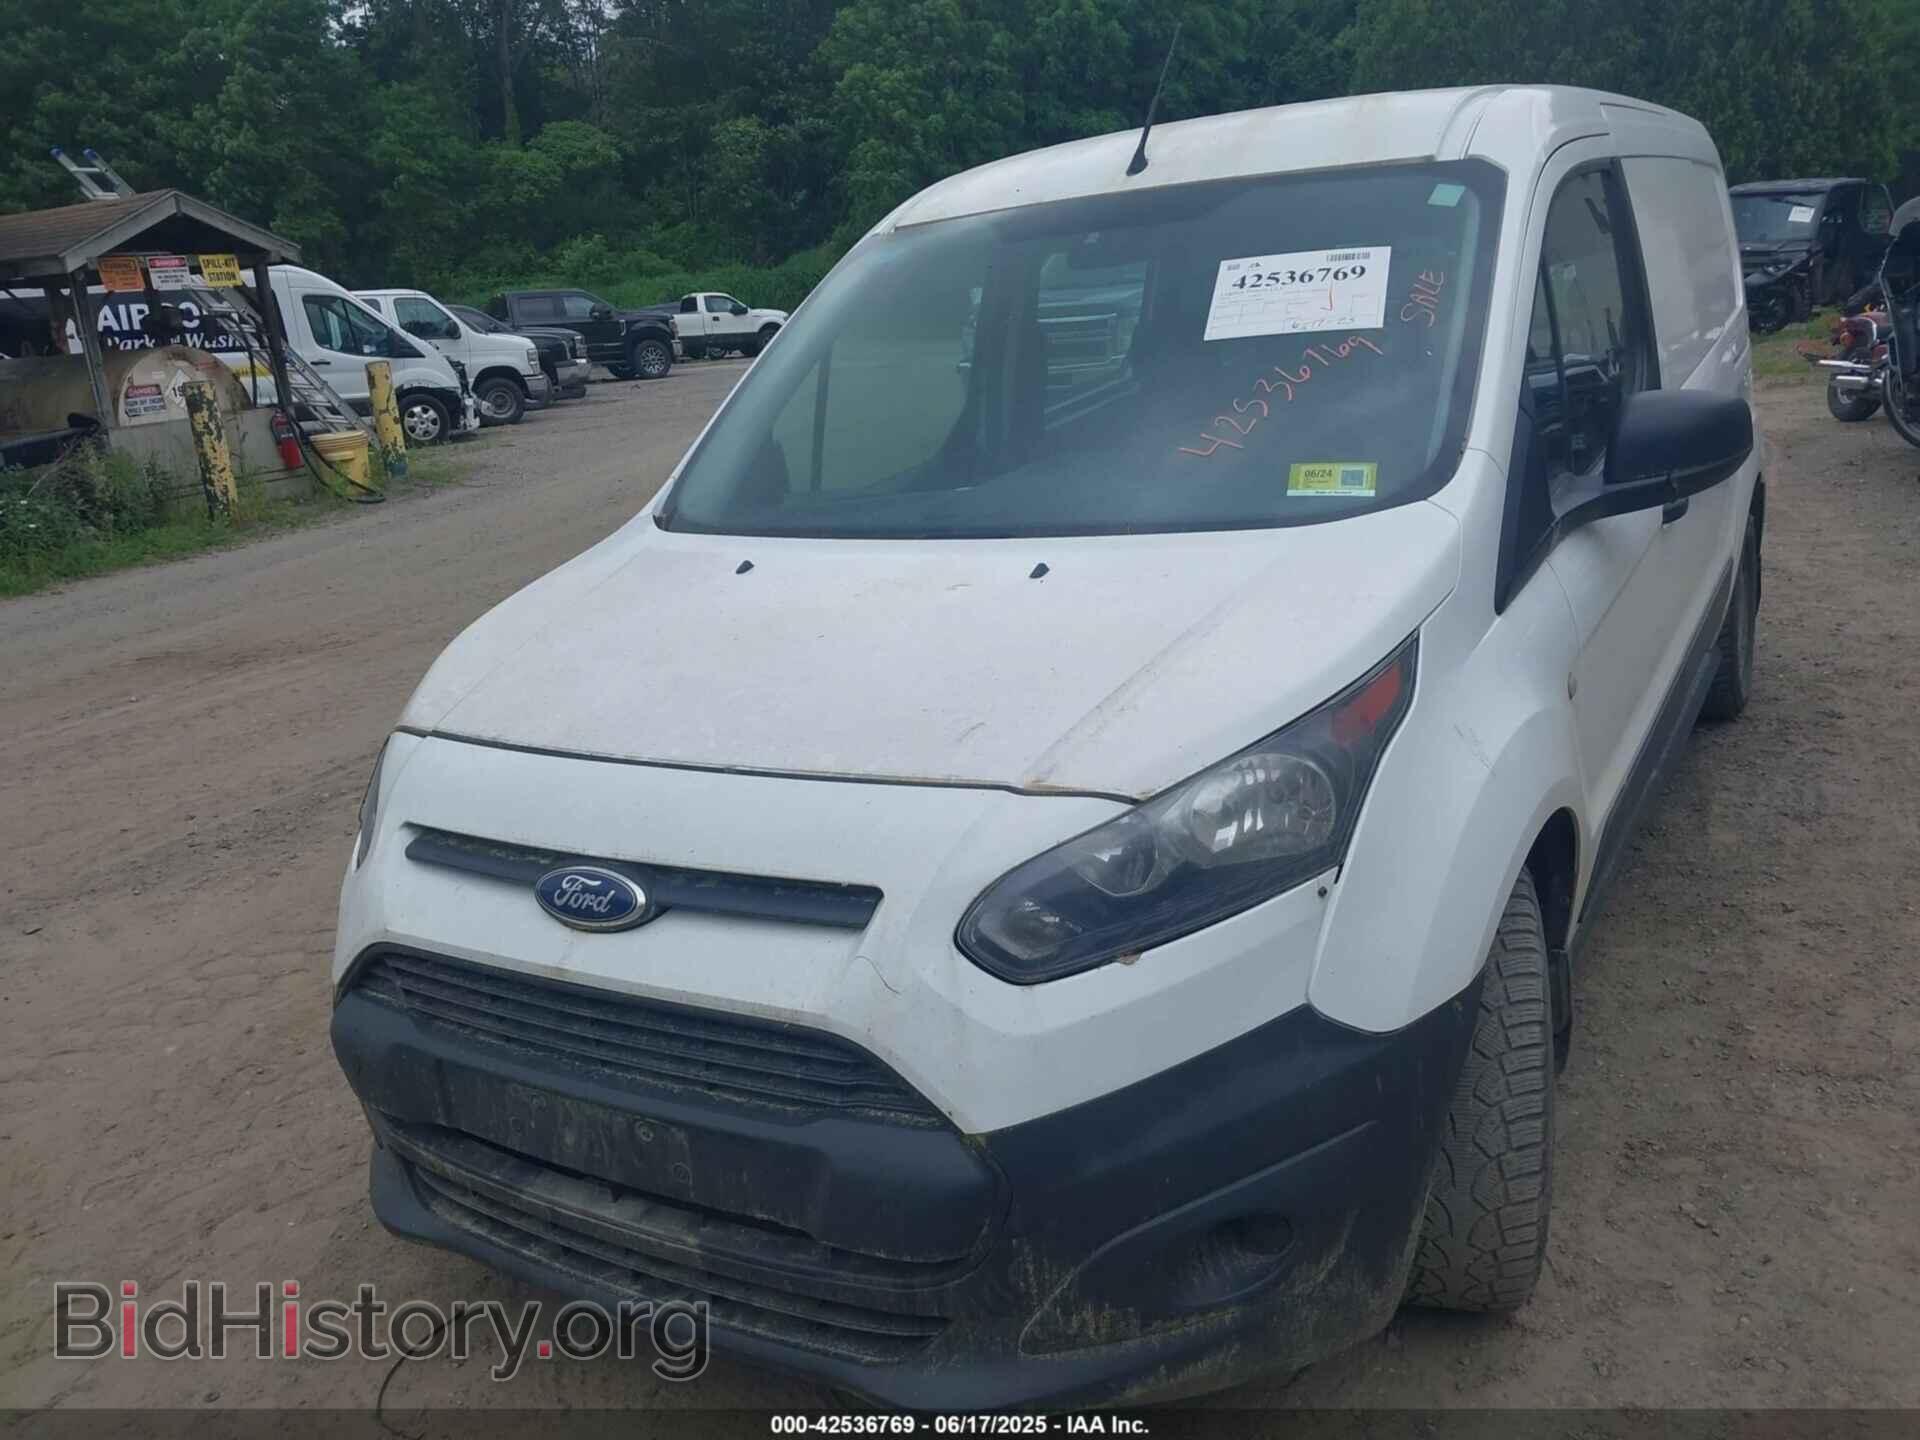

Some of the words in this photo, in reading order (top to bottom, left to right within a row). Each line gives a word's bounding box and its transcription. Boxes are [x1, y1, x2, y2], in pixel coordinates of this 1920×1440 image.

[208, 270, 237, 282] STATION
[1232, 265, 1366, 289] 42536769
[1304, 469, 1333, 479] 06/24
[553, 874, 616, 913] Ford
